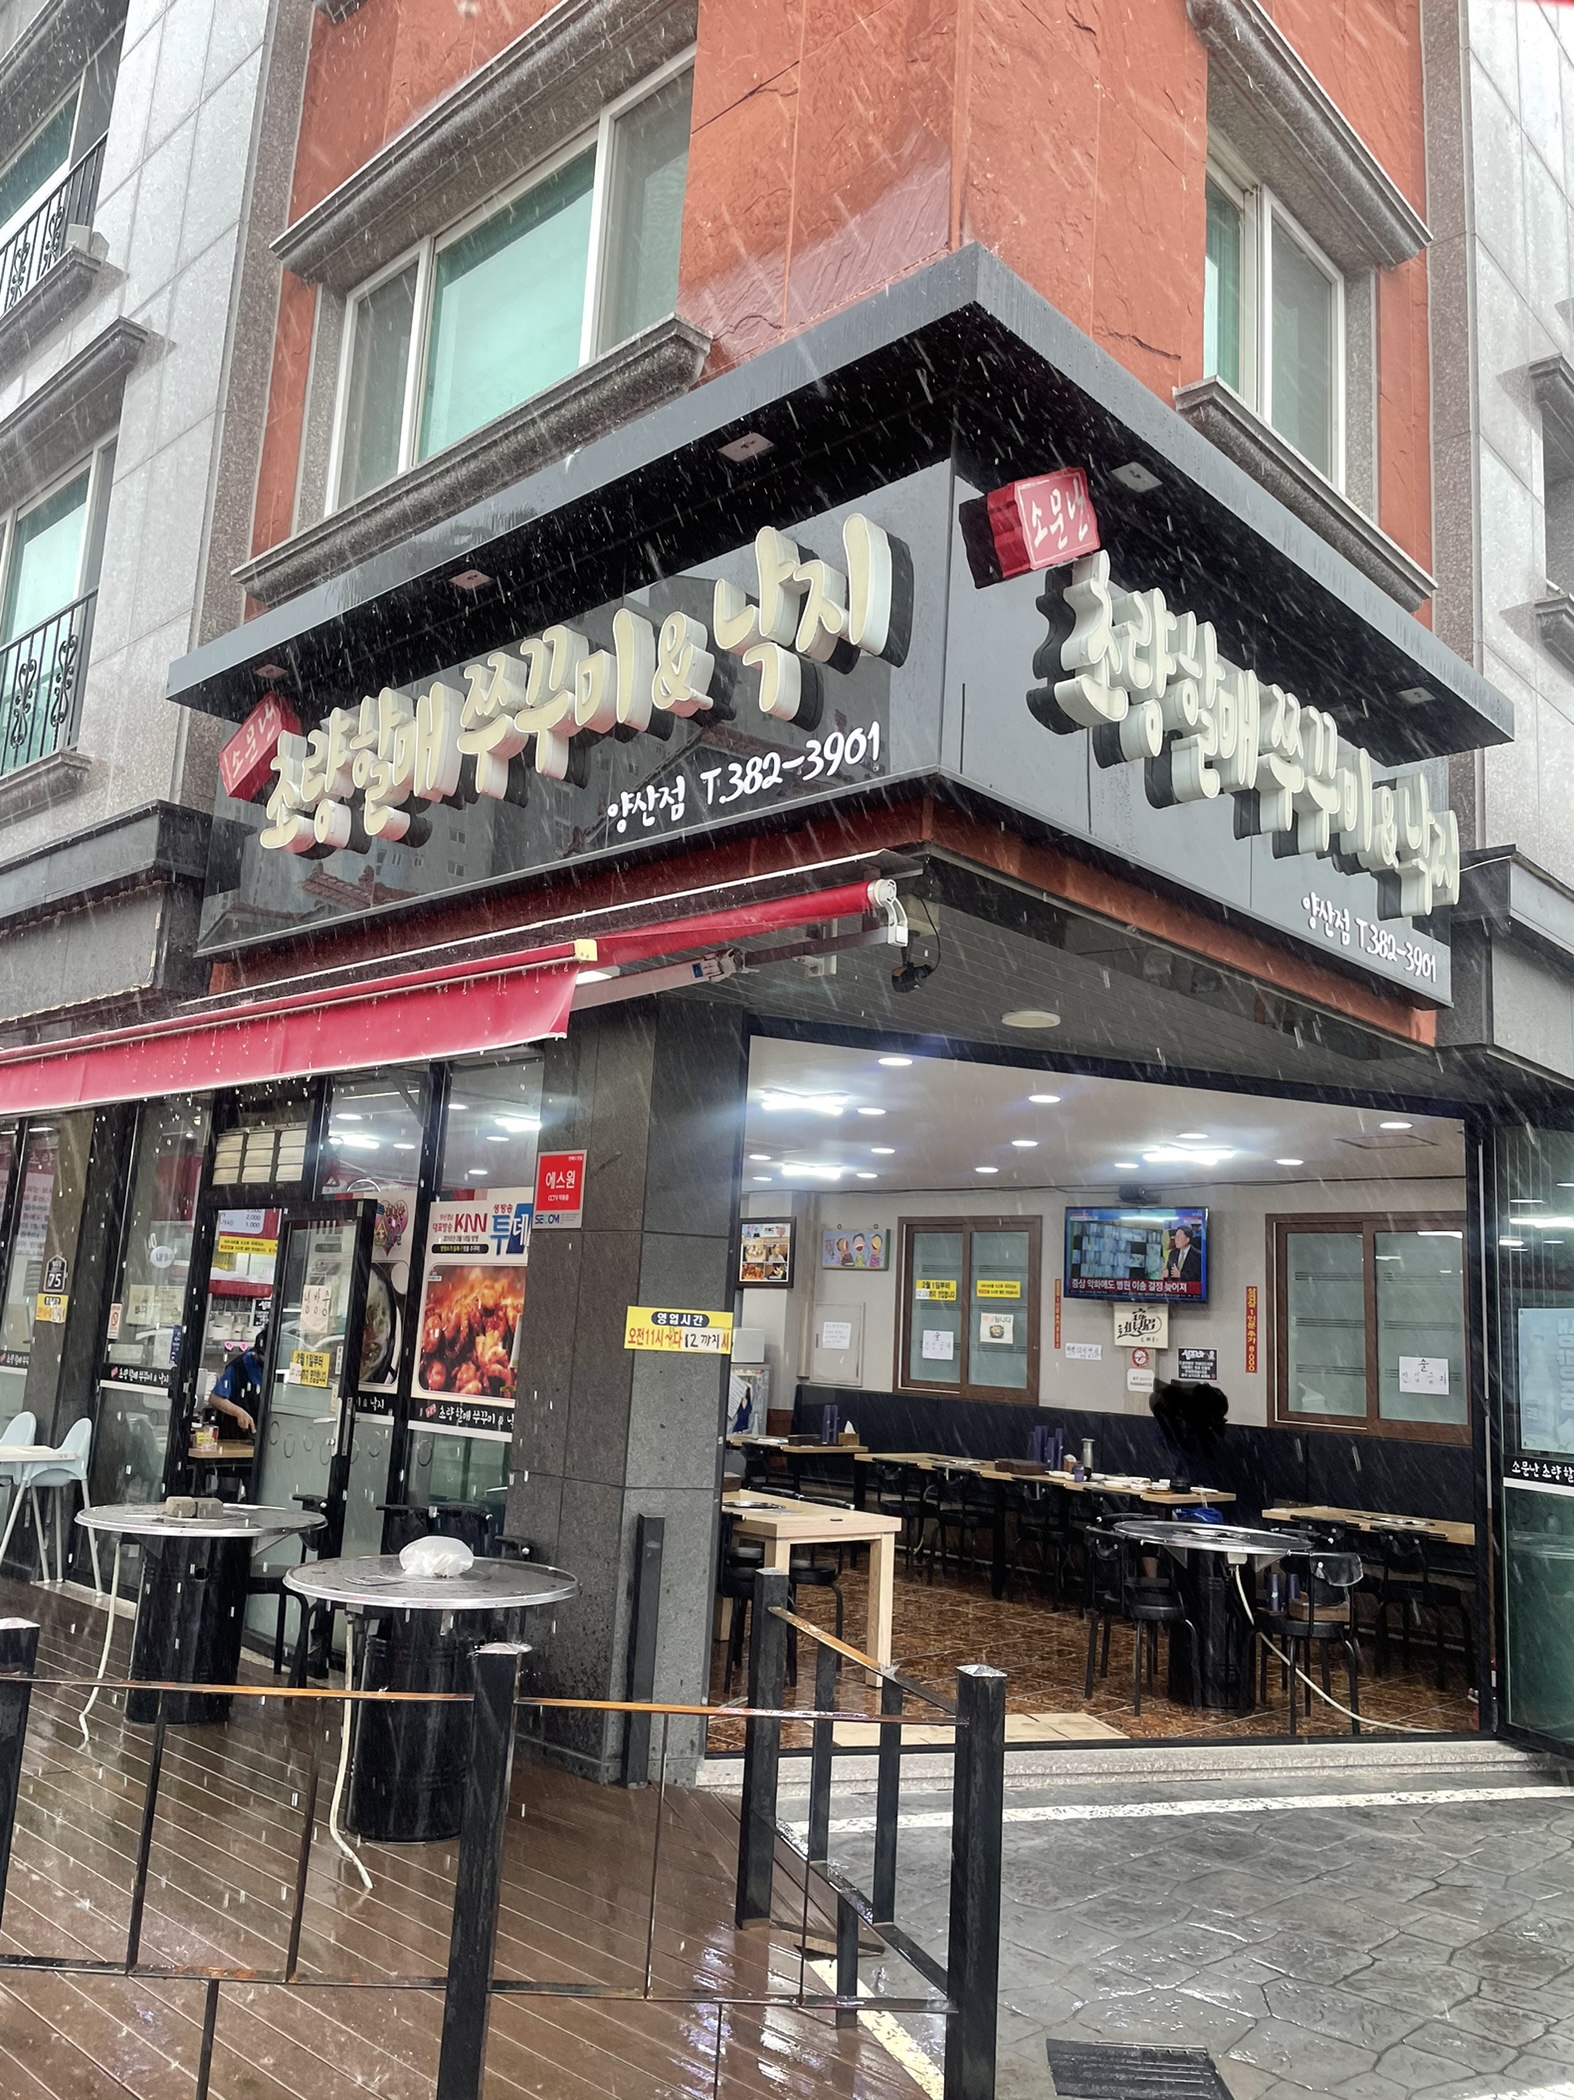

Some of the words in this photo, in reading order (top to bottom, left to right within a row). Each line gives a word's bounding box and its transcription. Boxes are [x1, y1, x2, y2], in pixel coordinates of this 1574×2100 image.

[1031, 478, 1089, 550] 소문난
[260, 681, 466, 852] 초량할매
[608, 775, 686, 833] 양산점
[1301, 891, 1351, 946] 양산점
[545, 1170, 576, 1190] 에스원
[493, 1203, 513, 1214] 생방송
[453, 1212, 488, 1233] KNN
[535, 1213, 560, 1225] SECOM
[48, 1273, 62, 1288] 75
[1071, 1279, 1086, 1289] 증상
[1087, 1279, 1115, 1290] 악화에도
[1116, 1280, 1131, 1290] 병원
[1131, 1280, 1147, 1291] 이송
[1148, 1281, 1164, 1292] 결정
[656, 1312, 704, 1327] 영업시간
[1418, 1358, 1430, 1373] 술
[370, 1396, 385, 1410] 낙지
[438, 1405, 471, 1424] 초량할매
[472, 1409, 496, 1425] 쭈꾸미
[1511, 1460, 1540, 1478] 소문난
